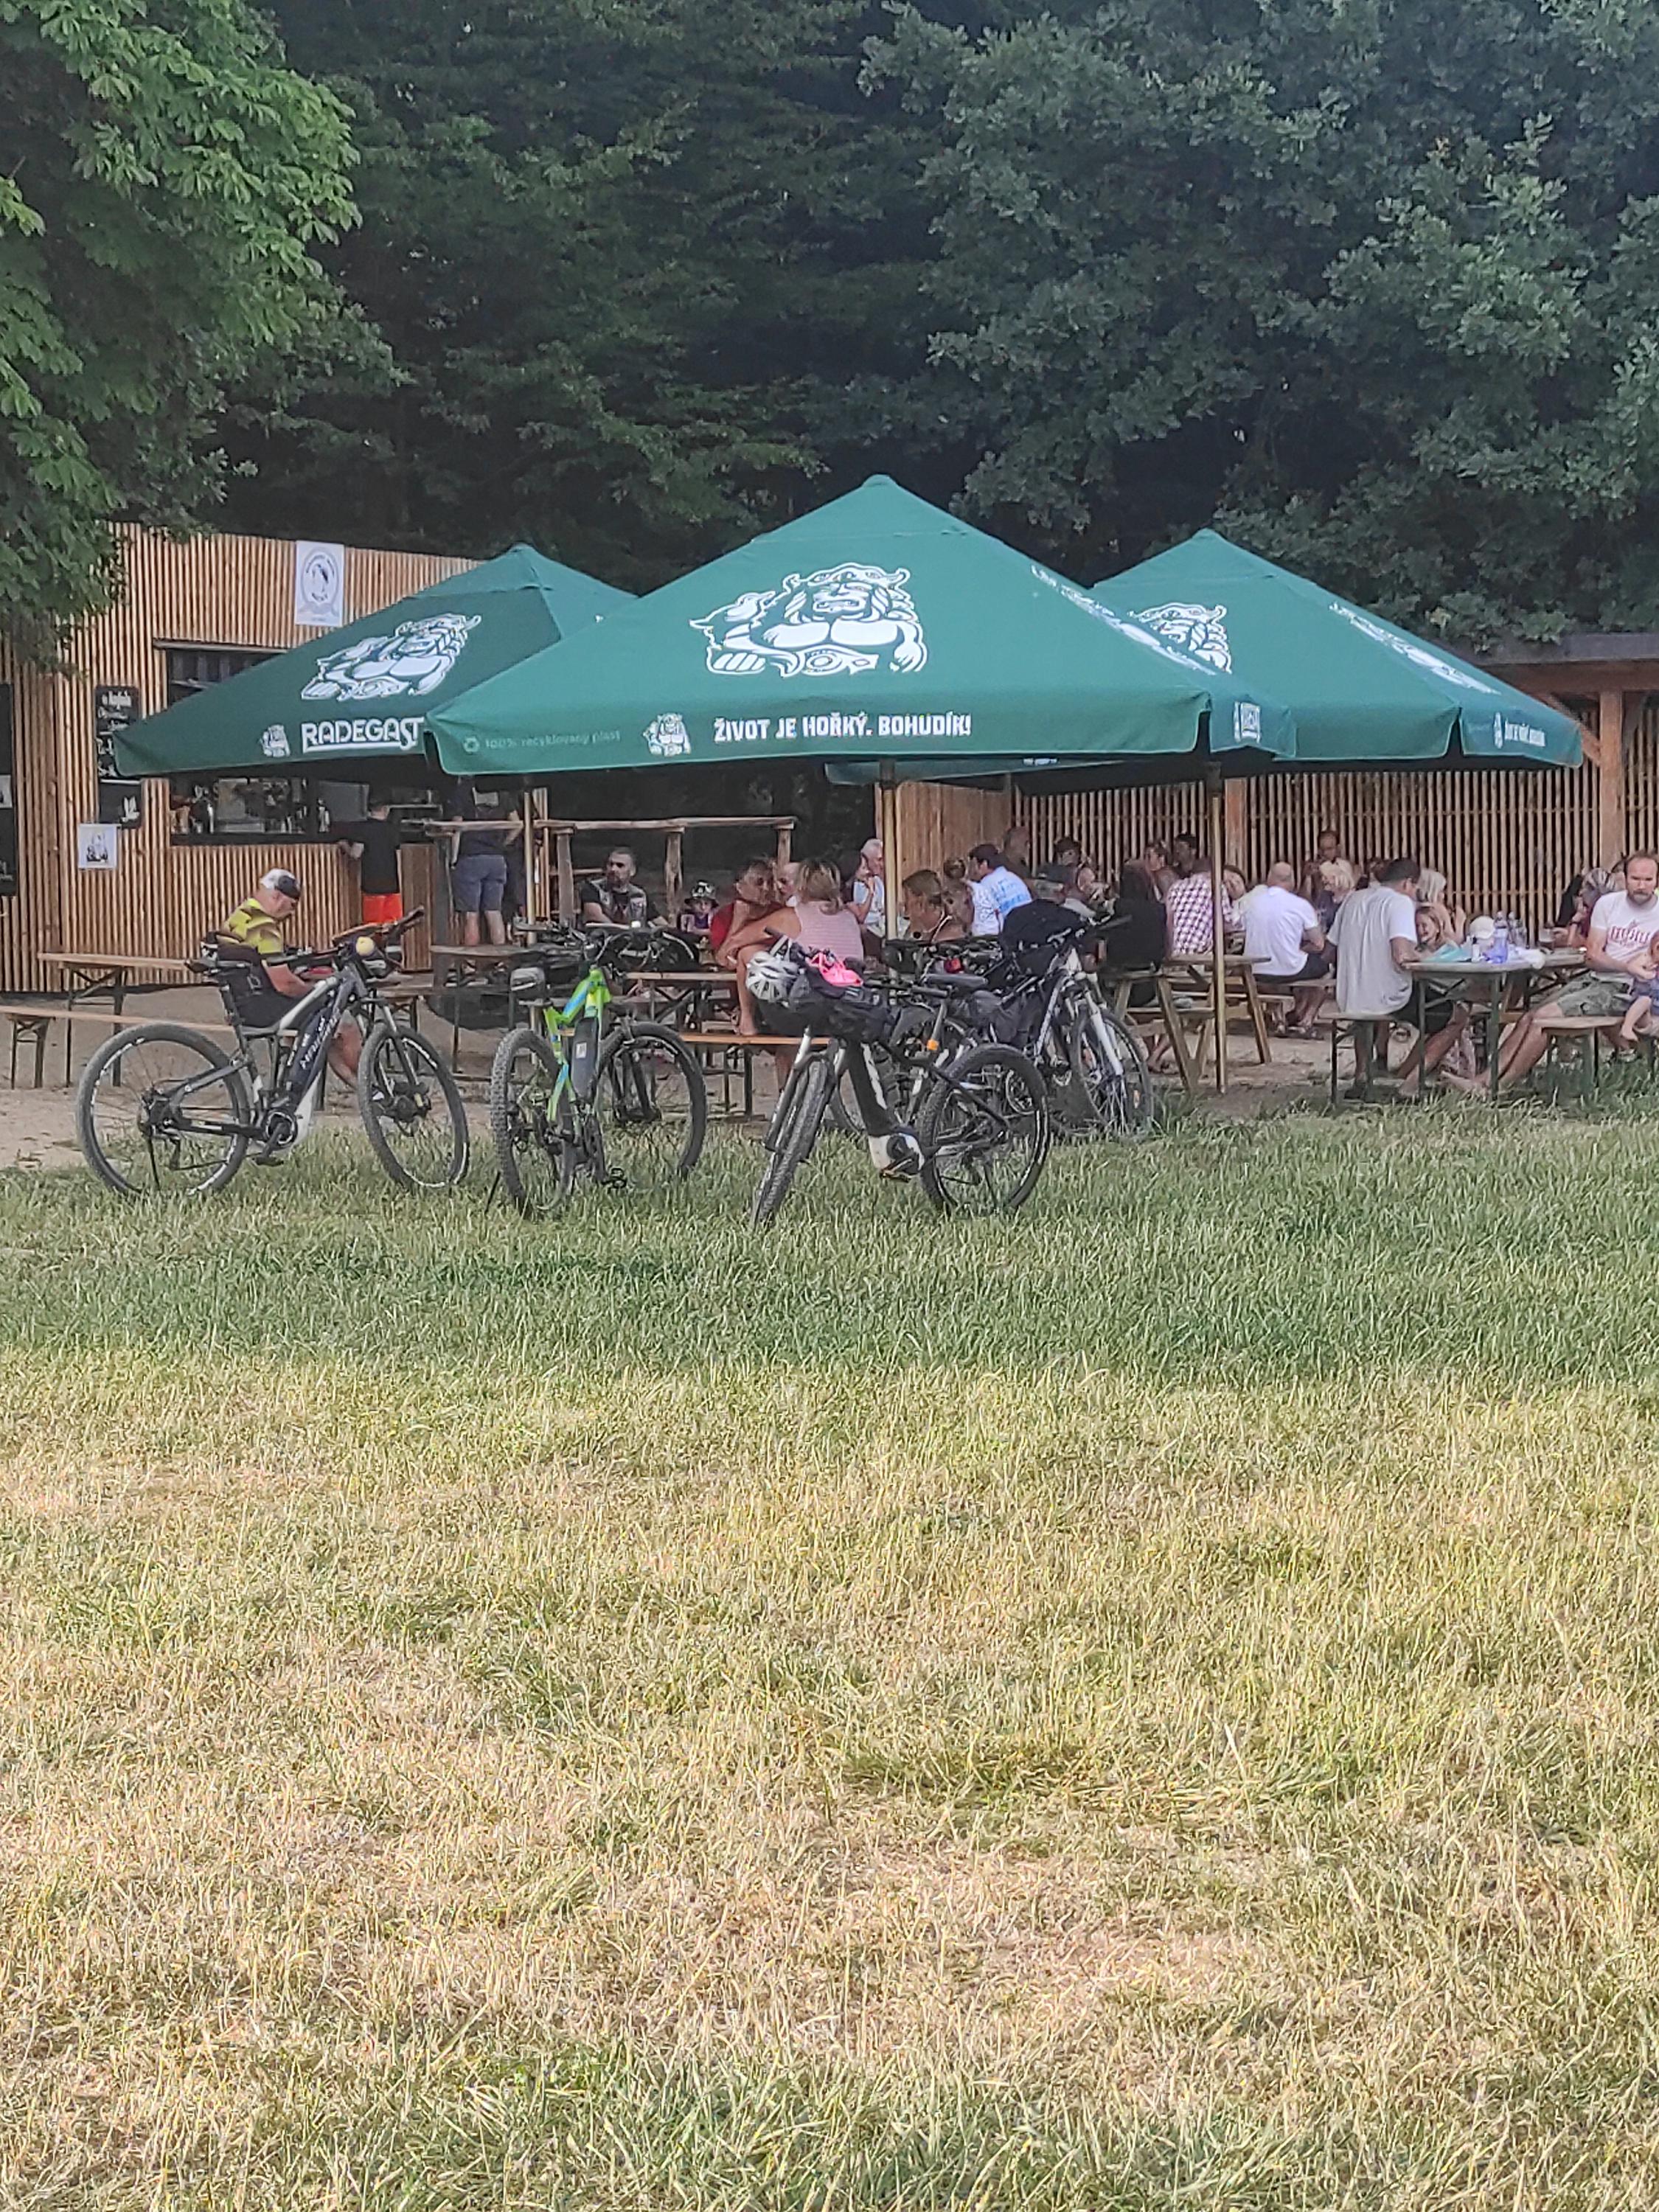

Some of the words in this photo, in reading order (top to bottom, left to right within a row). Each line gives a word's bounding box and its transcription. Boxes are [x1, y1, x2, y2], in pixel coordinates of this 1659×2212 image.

[302, 717, 425, 754] RADEGAST
[714, 717, 771, 743] ŽIVOT
[776, 717, 797, 738] JE
[802, 711, 873, 738] HOŘKÝ.
[878, 711, 971, 737] BOHUDÍK!
